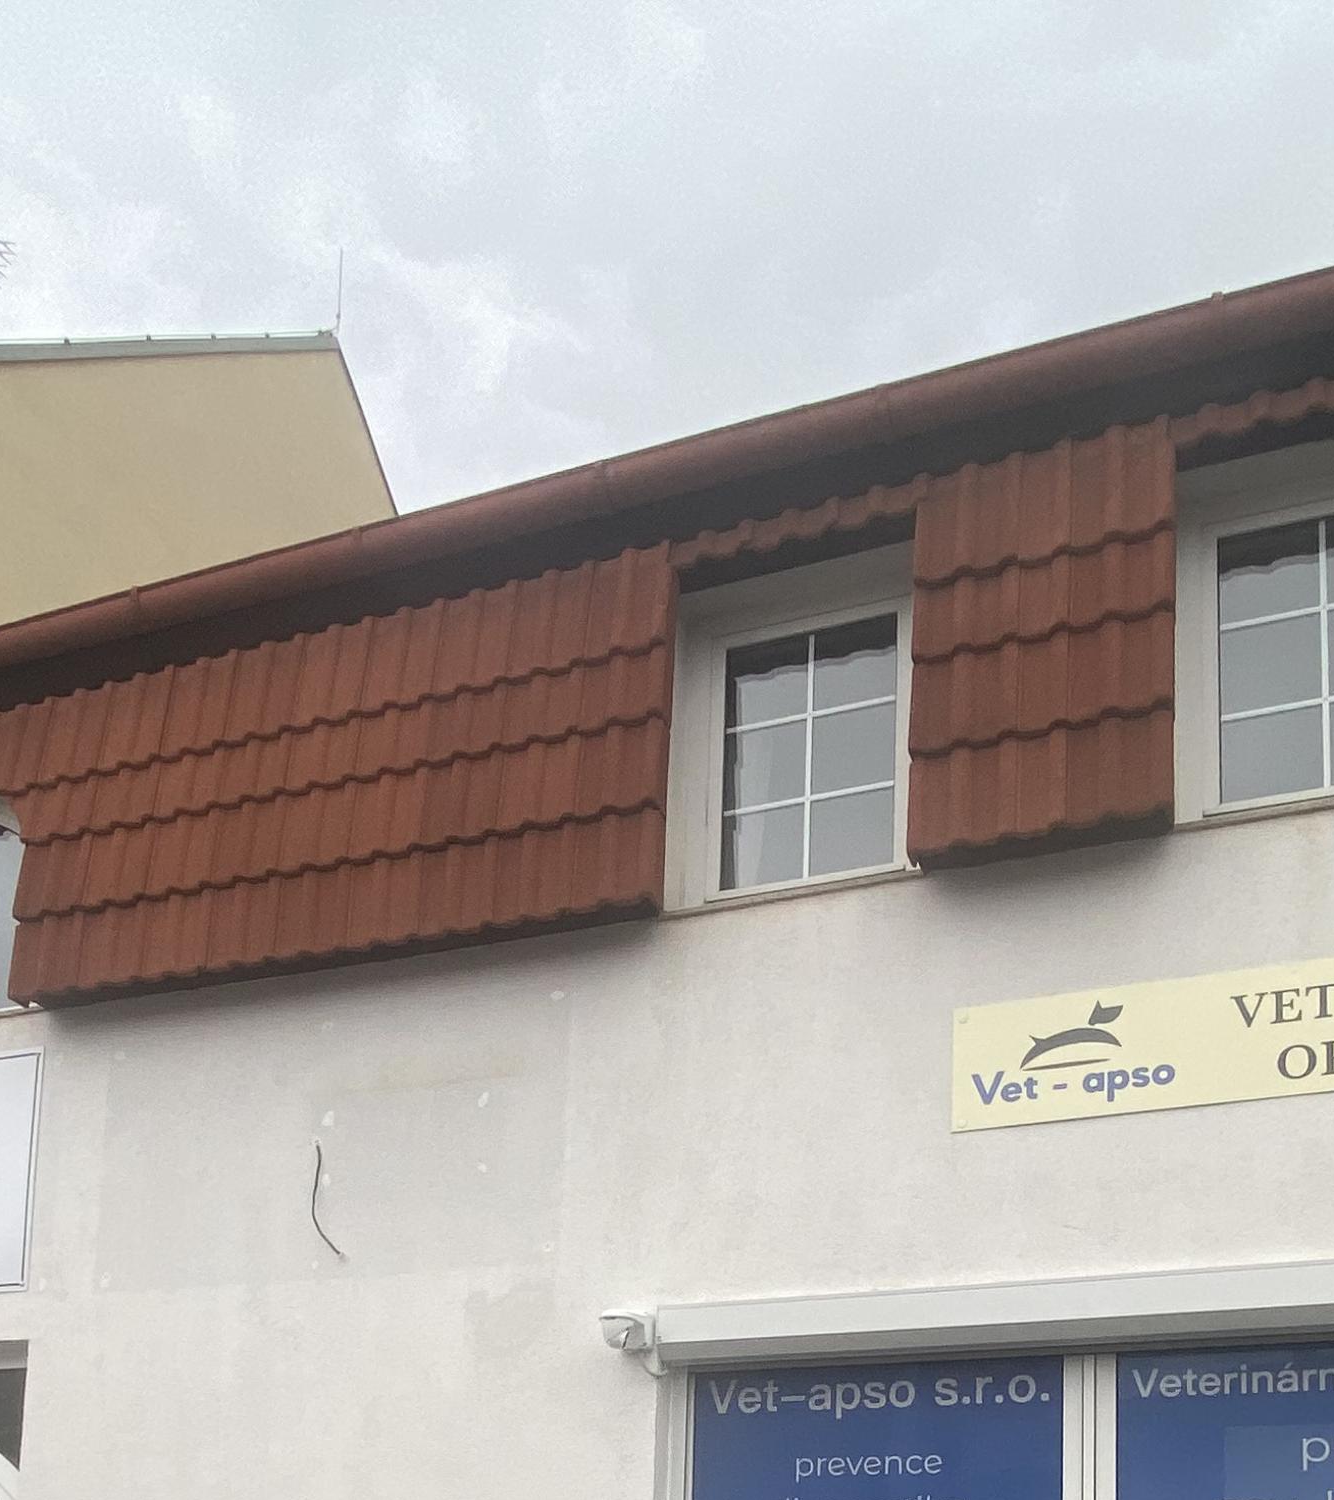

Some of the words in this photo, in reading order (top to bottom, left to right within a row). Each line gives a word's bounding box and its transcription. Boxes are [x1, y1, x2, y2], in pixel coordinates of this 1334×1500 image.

[971, 1071, 1038, 1106] Vet
[1082, 1060, 1176, 1102] apso
[709, 1378, 916, 1419] Vet-apso
[934, 1373, 1051, 1406] s.r.o.
[795, 1453, 943, 1483] prevence
